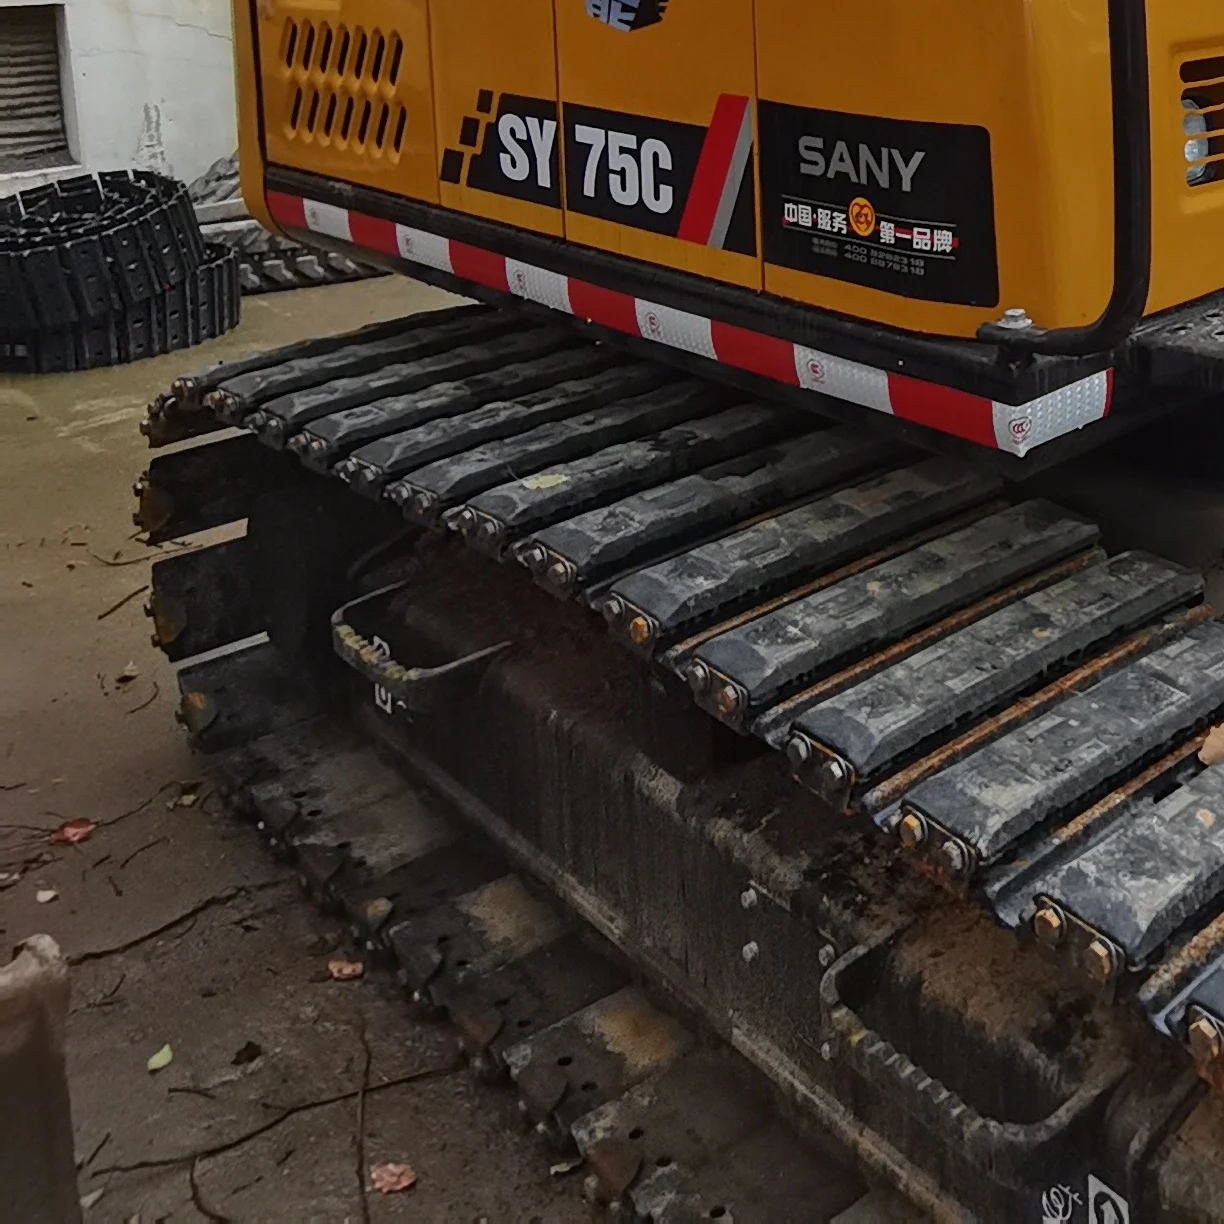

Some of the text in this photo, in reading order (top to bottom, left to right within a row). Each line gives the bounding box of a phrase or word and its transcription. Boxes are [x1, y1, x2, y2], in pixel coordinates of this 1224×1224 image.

[497, 112, 673, 214] SY 75C
[798, 135, 926, 193] SANY
[879, 220, 953, 253] 第一品牌
